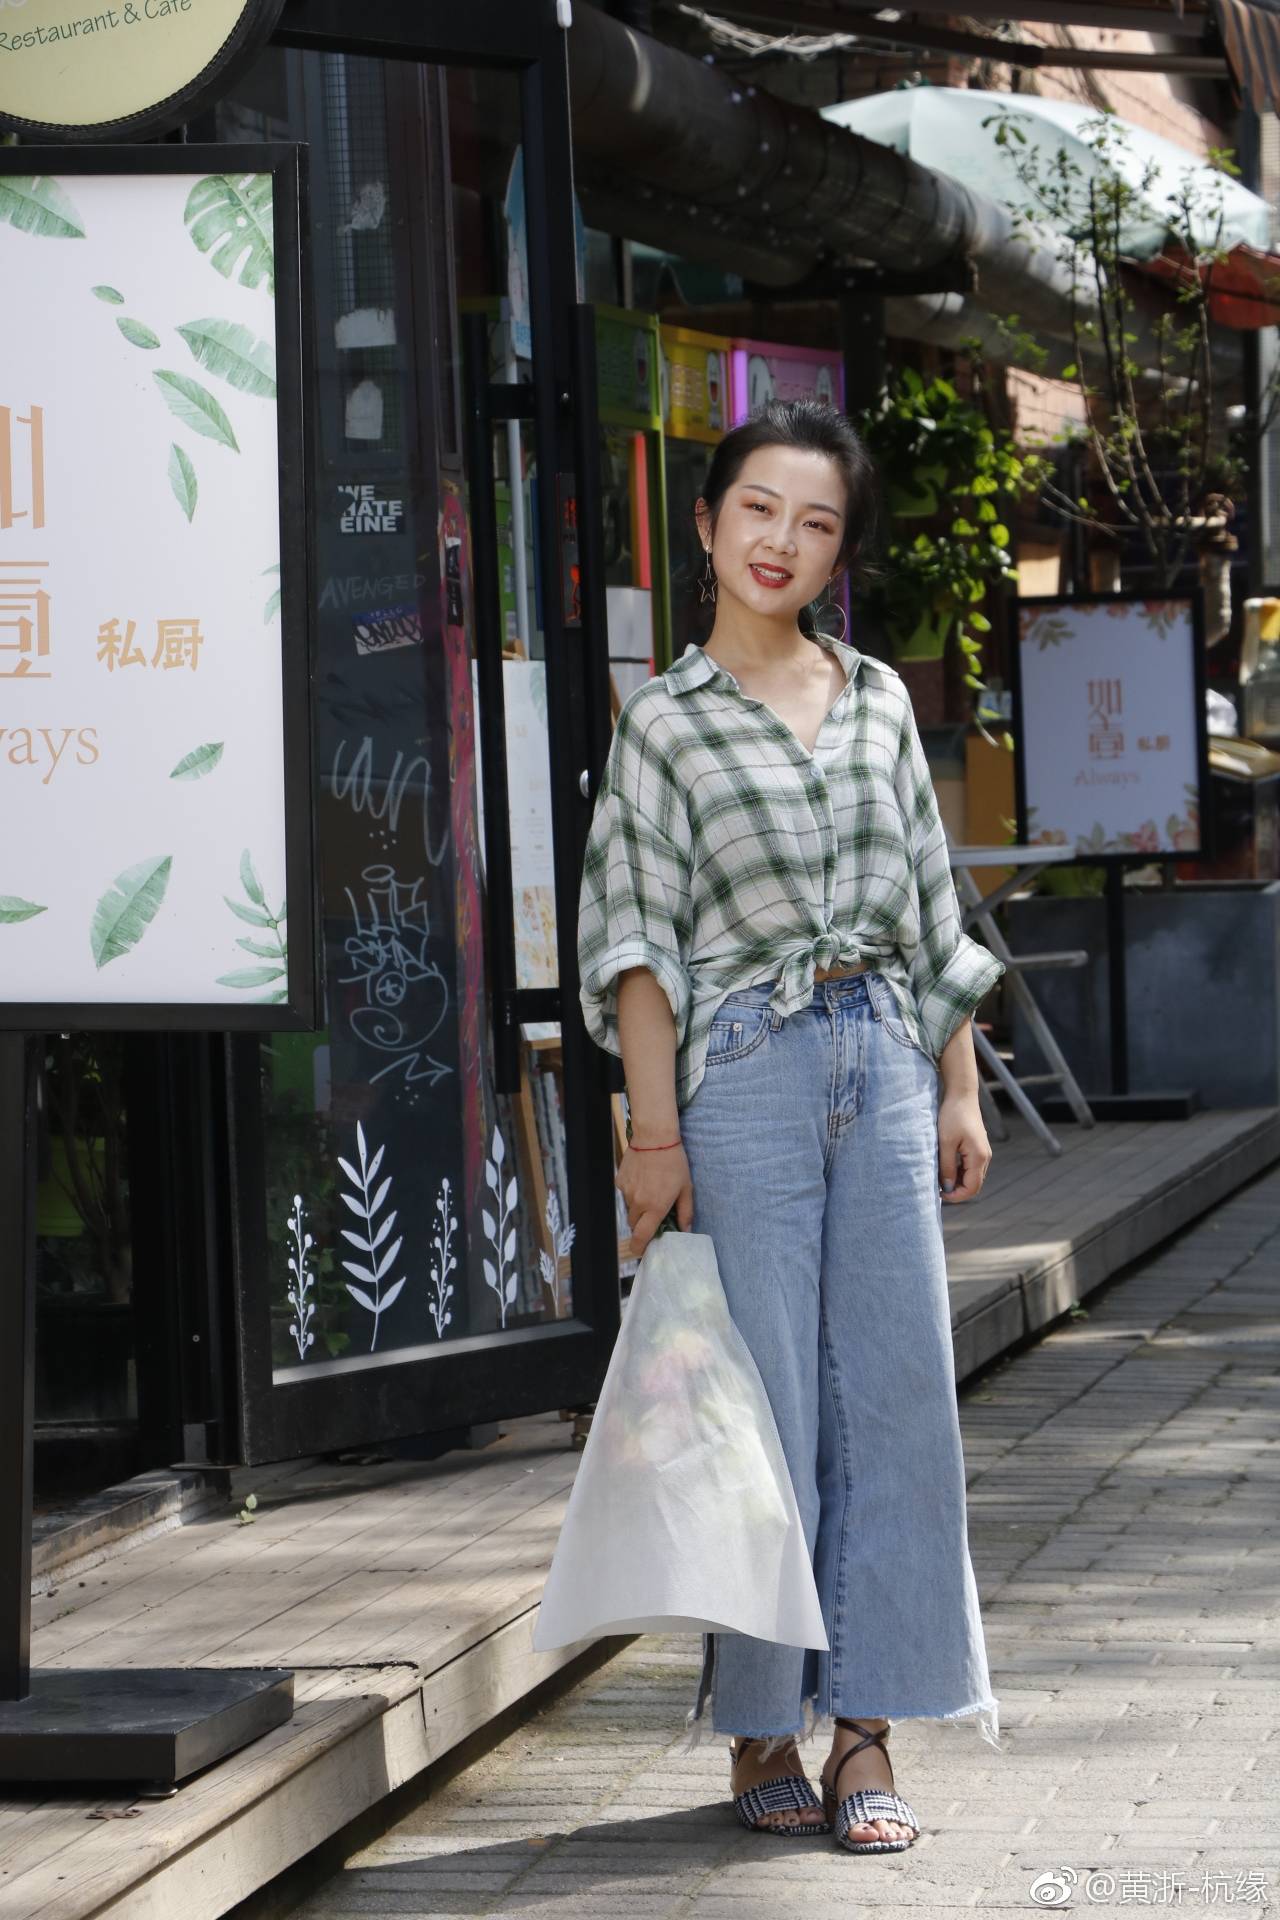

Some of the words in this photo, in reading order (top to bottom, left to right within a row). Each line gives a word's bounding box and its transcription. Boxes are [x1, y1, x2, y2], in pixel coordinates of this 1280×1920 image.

[123, 3, 141, 25] &
[340, 516, 397, 534] EINE
[96, 617, 205, 673] 私厨
[1073, 768, 1141, 791] Always
